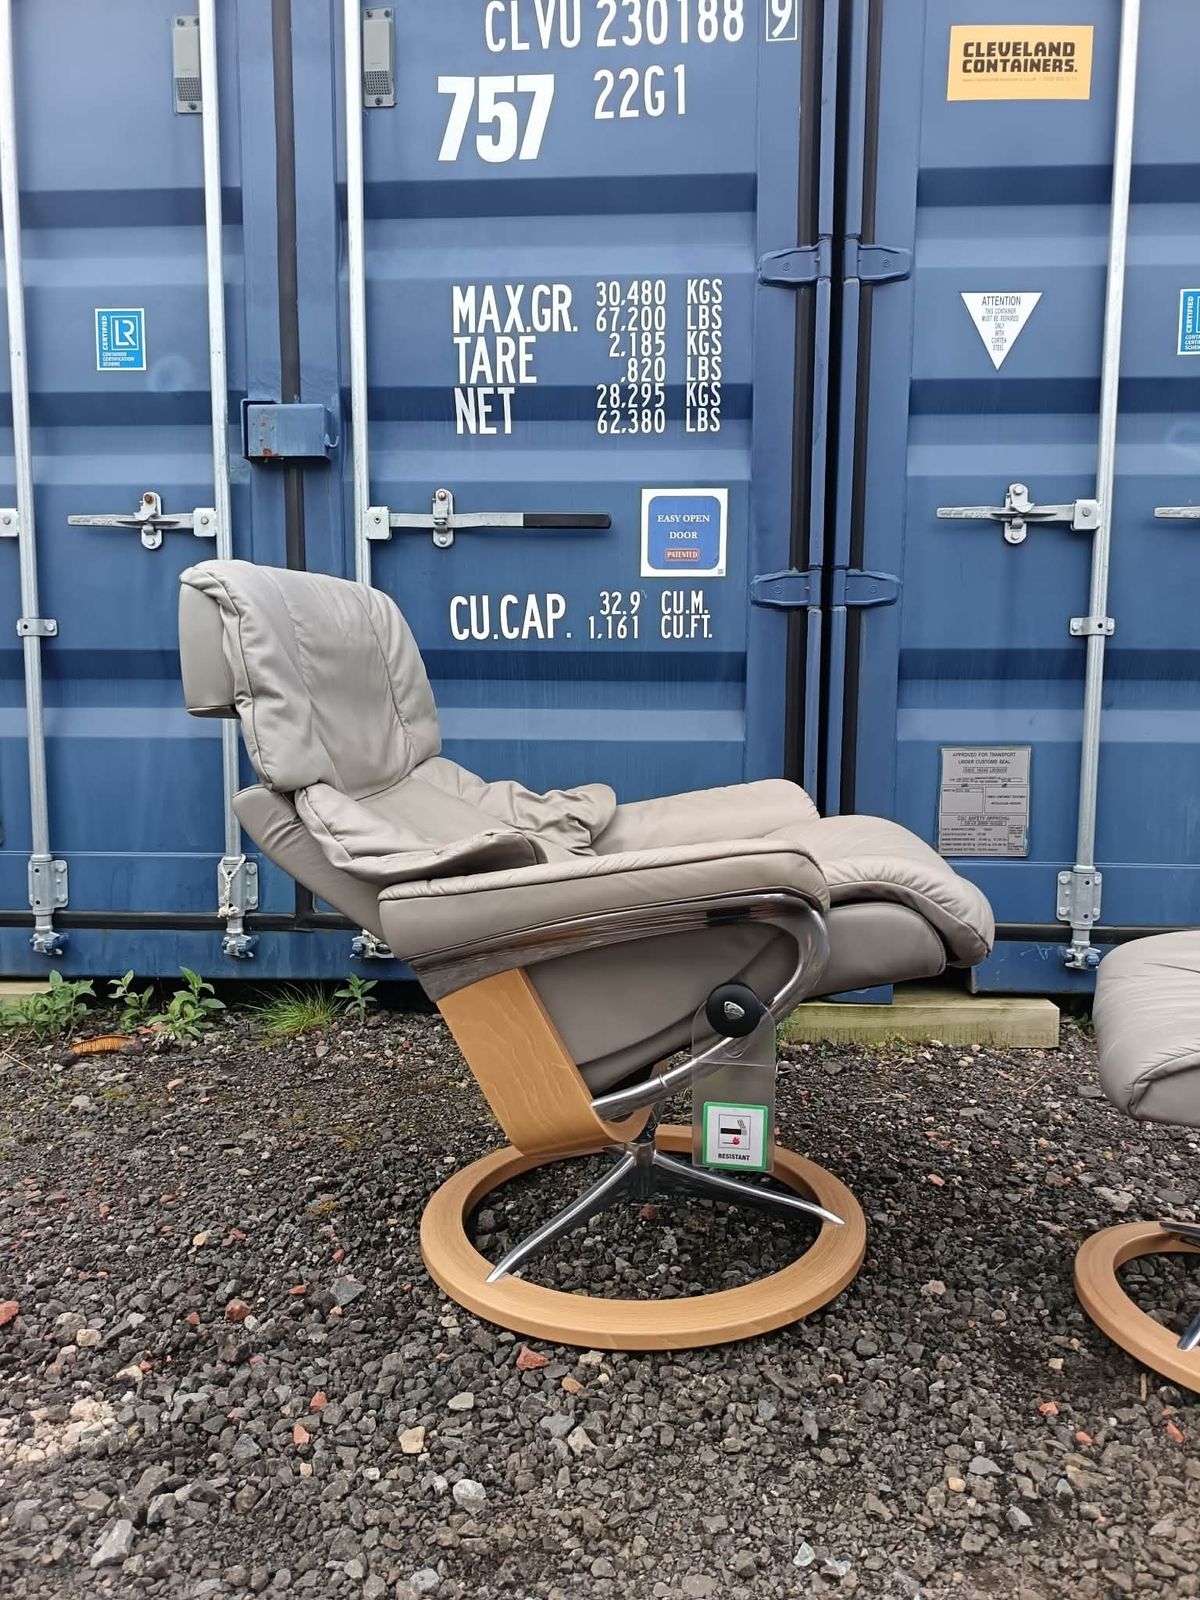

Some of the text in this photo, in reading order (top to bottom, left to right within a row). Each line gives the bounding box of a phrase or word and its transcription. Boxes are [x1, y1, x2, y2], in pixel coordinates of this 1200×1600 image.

[485, 0, 793, 52] CLVU 230188 9
[963, 42, 1076, 57] CLEVELAND
[962, 58, 1078, 73] CONTAINERS.
[437, 64, 686, 163] 757 22G1
[452, 279, 723, 333] MAX.GR. 30,480 KGS
[982, 296, 1021, 306] ATTENTION
[596, 305, 722, 332] 67,200 LBS
[115, 320, 136, 345] LR
[453, 330, 722, 384] TARE 2,185 KGS
[686, 356, 722, 381] LBS
[454, 382, 722, 434] NET 28,295 KGS
[597, 407, 721, 434] 62,380 LBS
[599, 591, 641, 615] 32.9
[661, 590, 709, 614] CU.M.
[588, 615, 713, 639] 1,161 CU.FT.
[718, 1153, 750, 1161] RESISTANT
